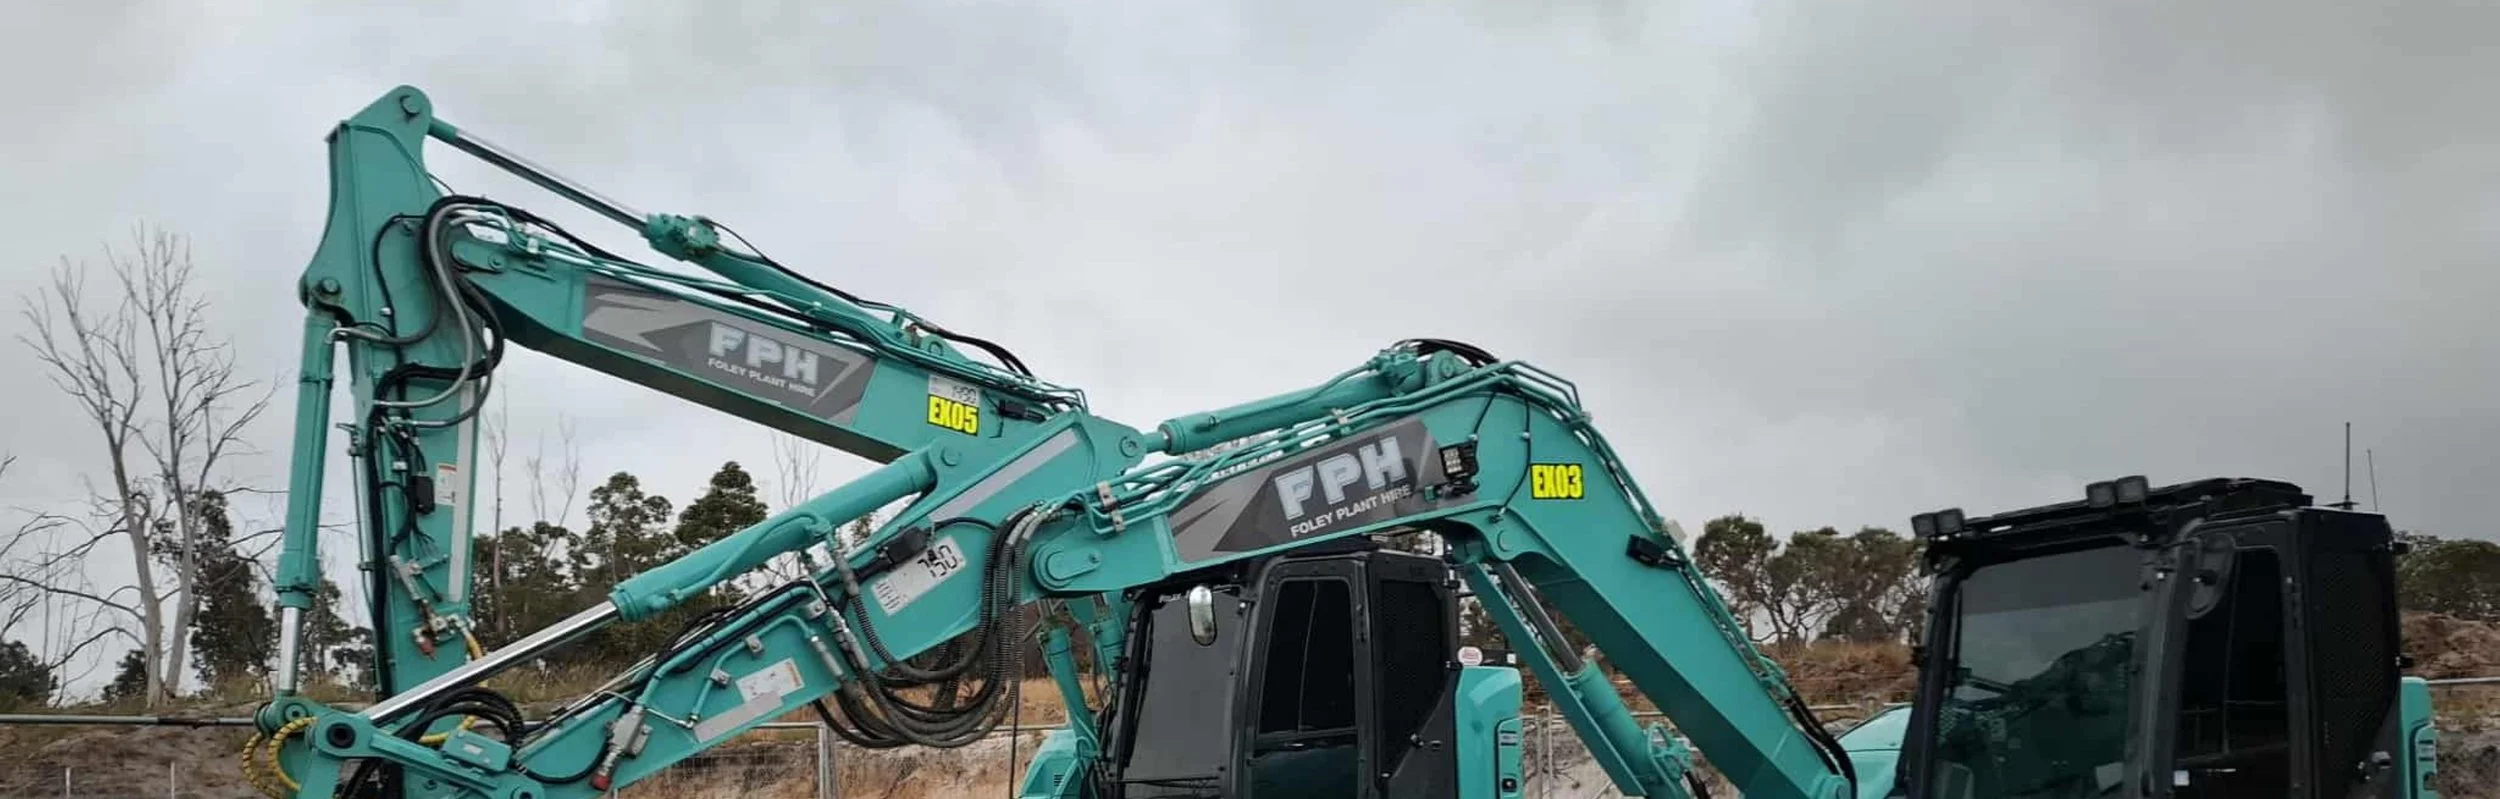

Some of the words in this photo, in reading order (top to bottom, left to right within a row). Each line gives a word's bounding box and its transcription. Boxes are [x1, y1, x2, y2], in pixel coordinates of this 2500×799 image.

[708, 357, 747, 377] FOLEY
[748, 369, 786, 388] PLANT
[788, 381, 815, 397] HIRE
[709, 321, 819, 385] FPH
[928, 394, 980, 436] EX05
[1274, 436, 1406, 520] FPH
[1530, 463, 1584, 499] EX03
[1290, 512, 1332, 538] FOLEY
[1336, 496, 1377, 520] PLANT
[1380, 484, 1411, 504] HIRE
